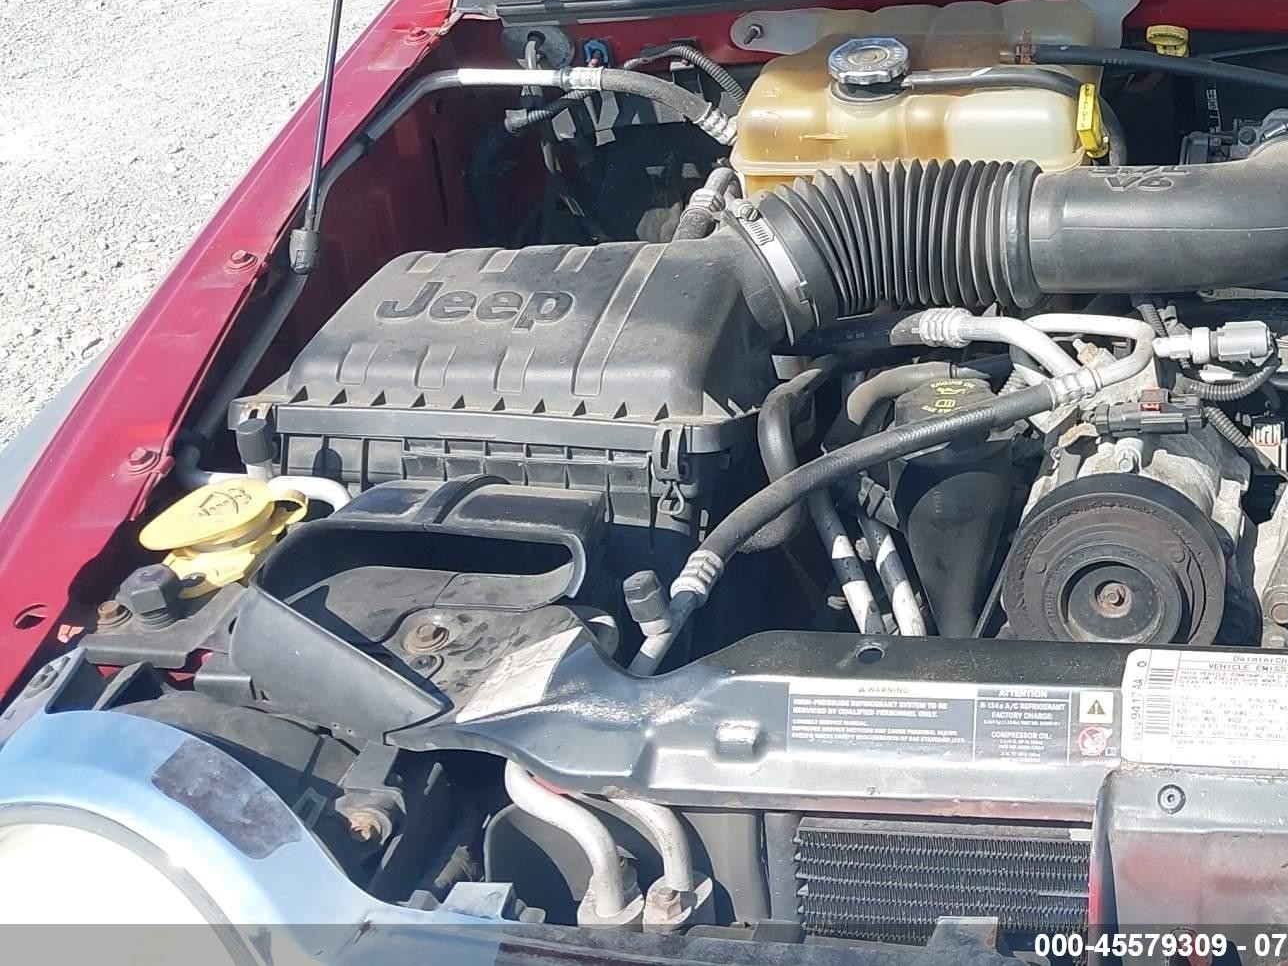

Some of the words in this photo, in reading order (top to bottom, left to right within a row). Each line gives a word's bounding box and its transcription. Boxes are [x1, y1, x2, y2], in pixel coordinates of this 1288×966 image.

[1104, 175, 1174, 191] V6
[376, 281, 576, 334] Jeep
[1209, 663, 1250, 671] VEHICLE
[998, 689, 1048, 698] ATTENTION
[1005, 702, 1019, 711] A/C
[1020, 703, 1066, 711] REFRIGERANT
[838, 708, 875, 716] QUALIFIED
[876, 709, 917, 717] PERSONNEL
[991, 711, 1022, 719] FACTORY
[991, 731, 1038, 739] COMPRESSOR
